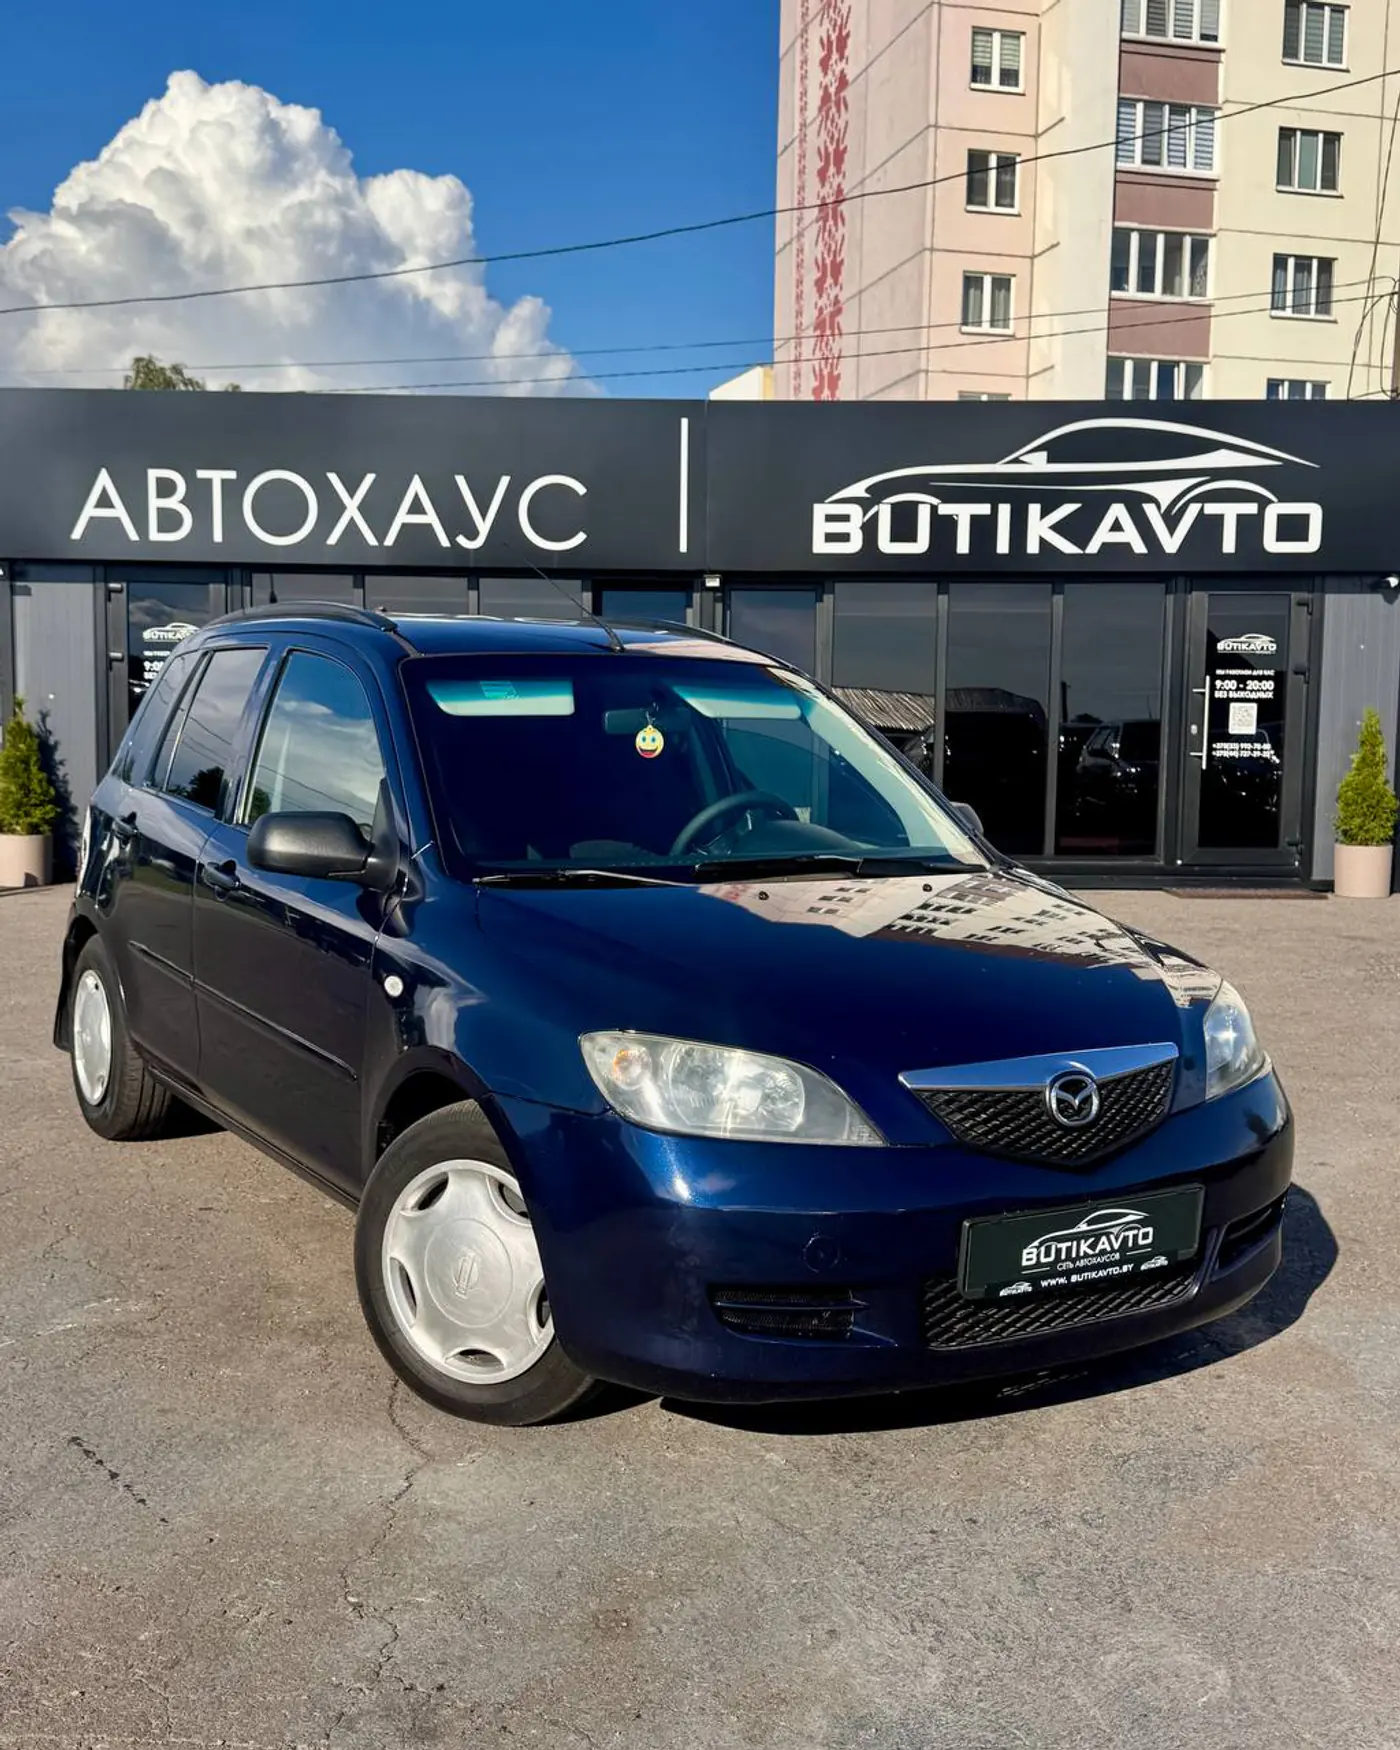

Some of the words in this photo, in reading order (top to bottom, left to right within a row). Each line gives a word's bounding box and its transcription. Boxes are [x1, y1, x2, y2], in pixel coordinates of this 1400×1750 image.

[71, 467, 588, 551] АВТОХАУС
[811, 502, 1323, 555] BUTIKAVTO
[1216, 642, 1277, 651] BUTIKAVTO
[1214, 690, 1228, 698] БЕЗ
[1228, 690, 1274, 699] ВЫХОДНЫХ
[1215, 679, 1238, 690] 9:00
[1245, 680, 1275, 691] 20:00
[1021, 1226, 1154, 1267] BUTIKAVTO
[1056, 1261, 1074, 1271] СЕТЬ
[1075, 1252, 1120, 1268] АВТОХАУСОВ
[1070, 1263, 1134, 1282] BUTIKAVTO.BY
